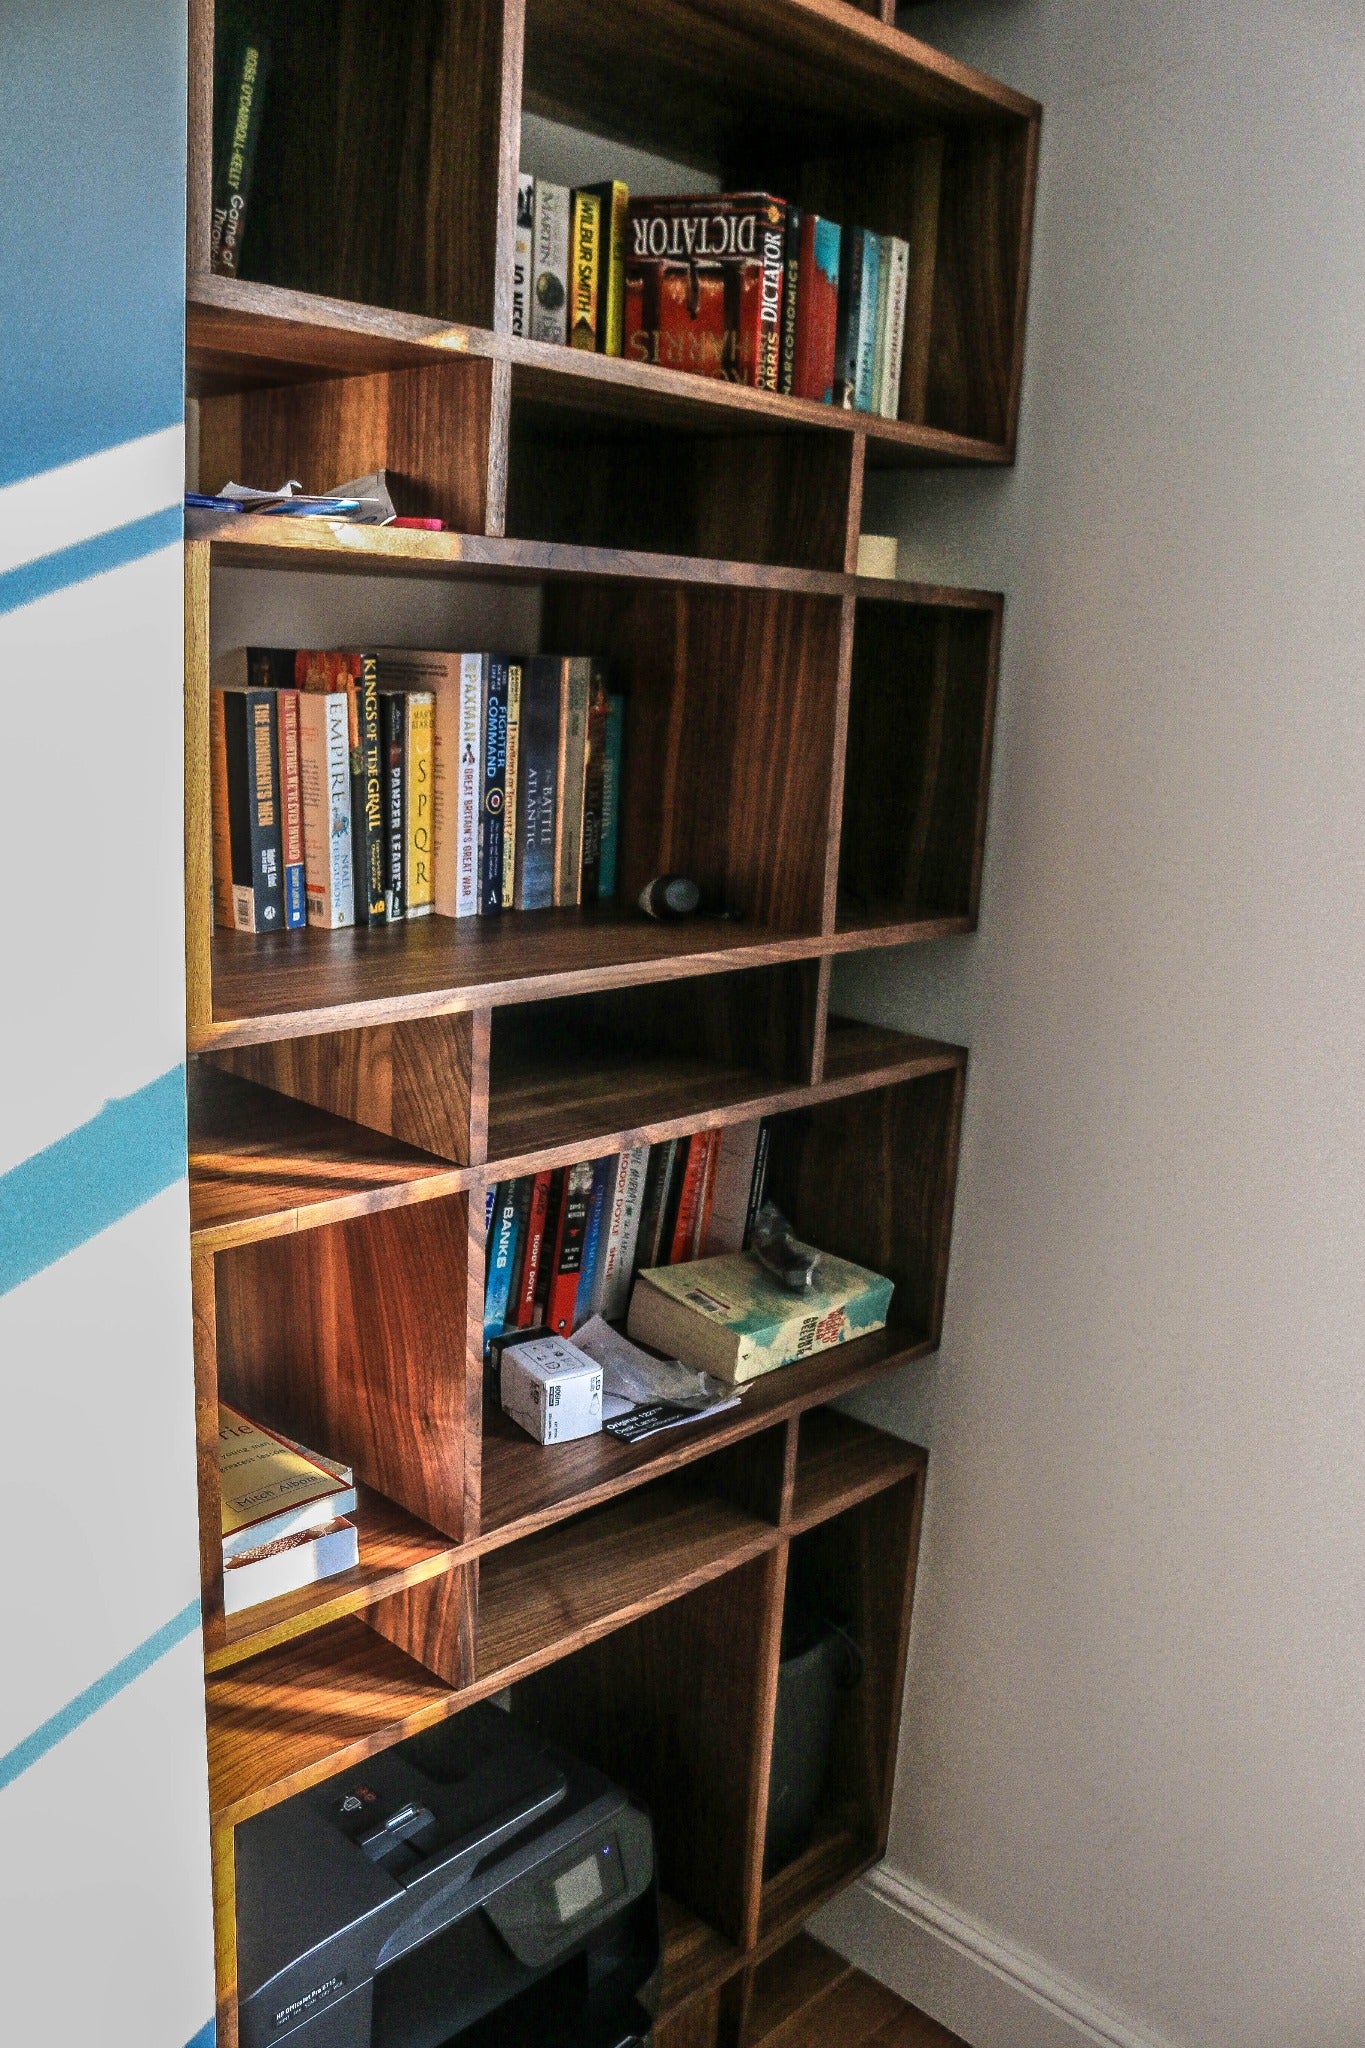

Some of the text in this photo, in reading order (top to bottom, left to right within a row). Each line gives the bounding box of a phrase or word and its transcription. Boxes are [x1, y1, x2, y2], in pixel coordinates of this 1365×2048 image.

[221, 194, 244, 267] Game of
[577, 201, 594, 313] WILBUR SMITH
[631, 215, 756, 256] DICTATOR
[761, 231, 784, 323] DICTATOR
[629, 329, 754, 363] HARRIS
[764, 331, 780, 390] ARRIS
[284, 694, 296, 709] ALL
[363, 659, 378, 721] KINGS
[464, 672, 477, 743] PAXMAN
[285, 711, 297, 729] THE
[366, 722, 378, 741] OF
[487, 696, 499, 778] COMMAND
[498, 706, 507, 768] FIGHTER
[254, 703, 274, 827] THE MONUMENTS MEN
[330, 703, 346, 804] EMPIRE
[365, 777, 380, 832] GRAIL
[391, 767, 401, 829] PANZER
[527, 768, 537, 850] ATLANTIC
[541, 786, 553, 845] BATTLE
[289, 825, 300, 860] INVADED
[462, 768, 474, 897] GREAT BRITAIN'S GREAT WAR
[340, 854, 350, 889] NIALL
[618, 1153, 630, 1194] RODDY
[611, 1198, 624, 1237] DOYLE
[525, 1234, 540, 1303] RODDY DOYLE
[219, 1425, 254, 1441] rie
[220, 1447, 251, 1460] young
[236, 1475, 318, 1507] Mitch Albom
[276, 2010, 285, 2021] HP
[311, 1988, 322, 1998] Pro
